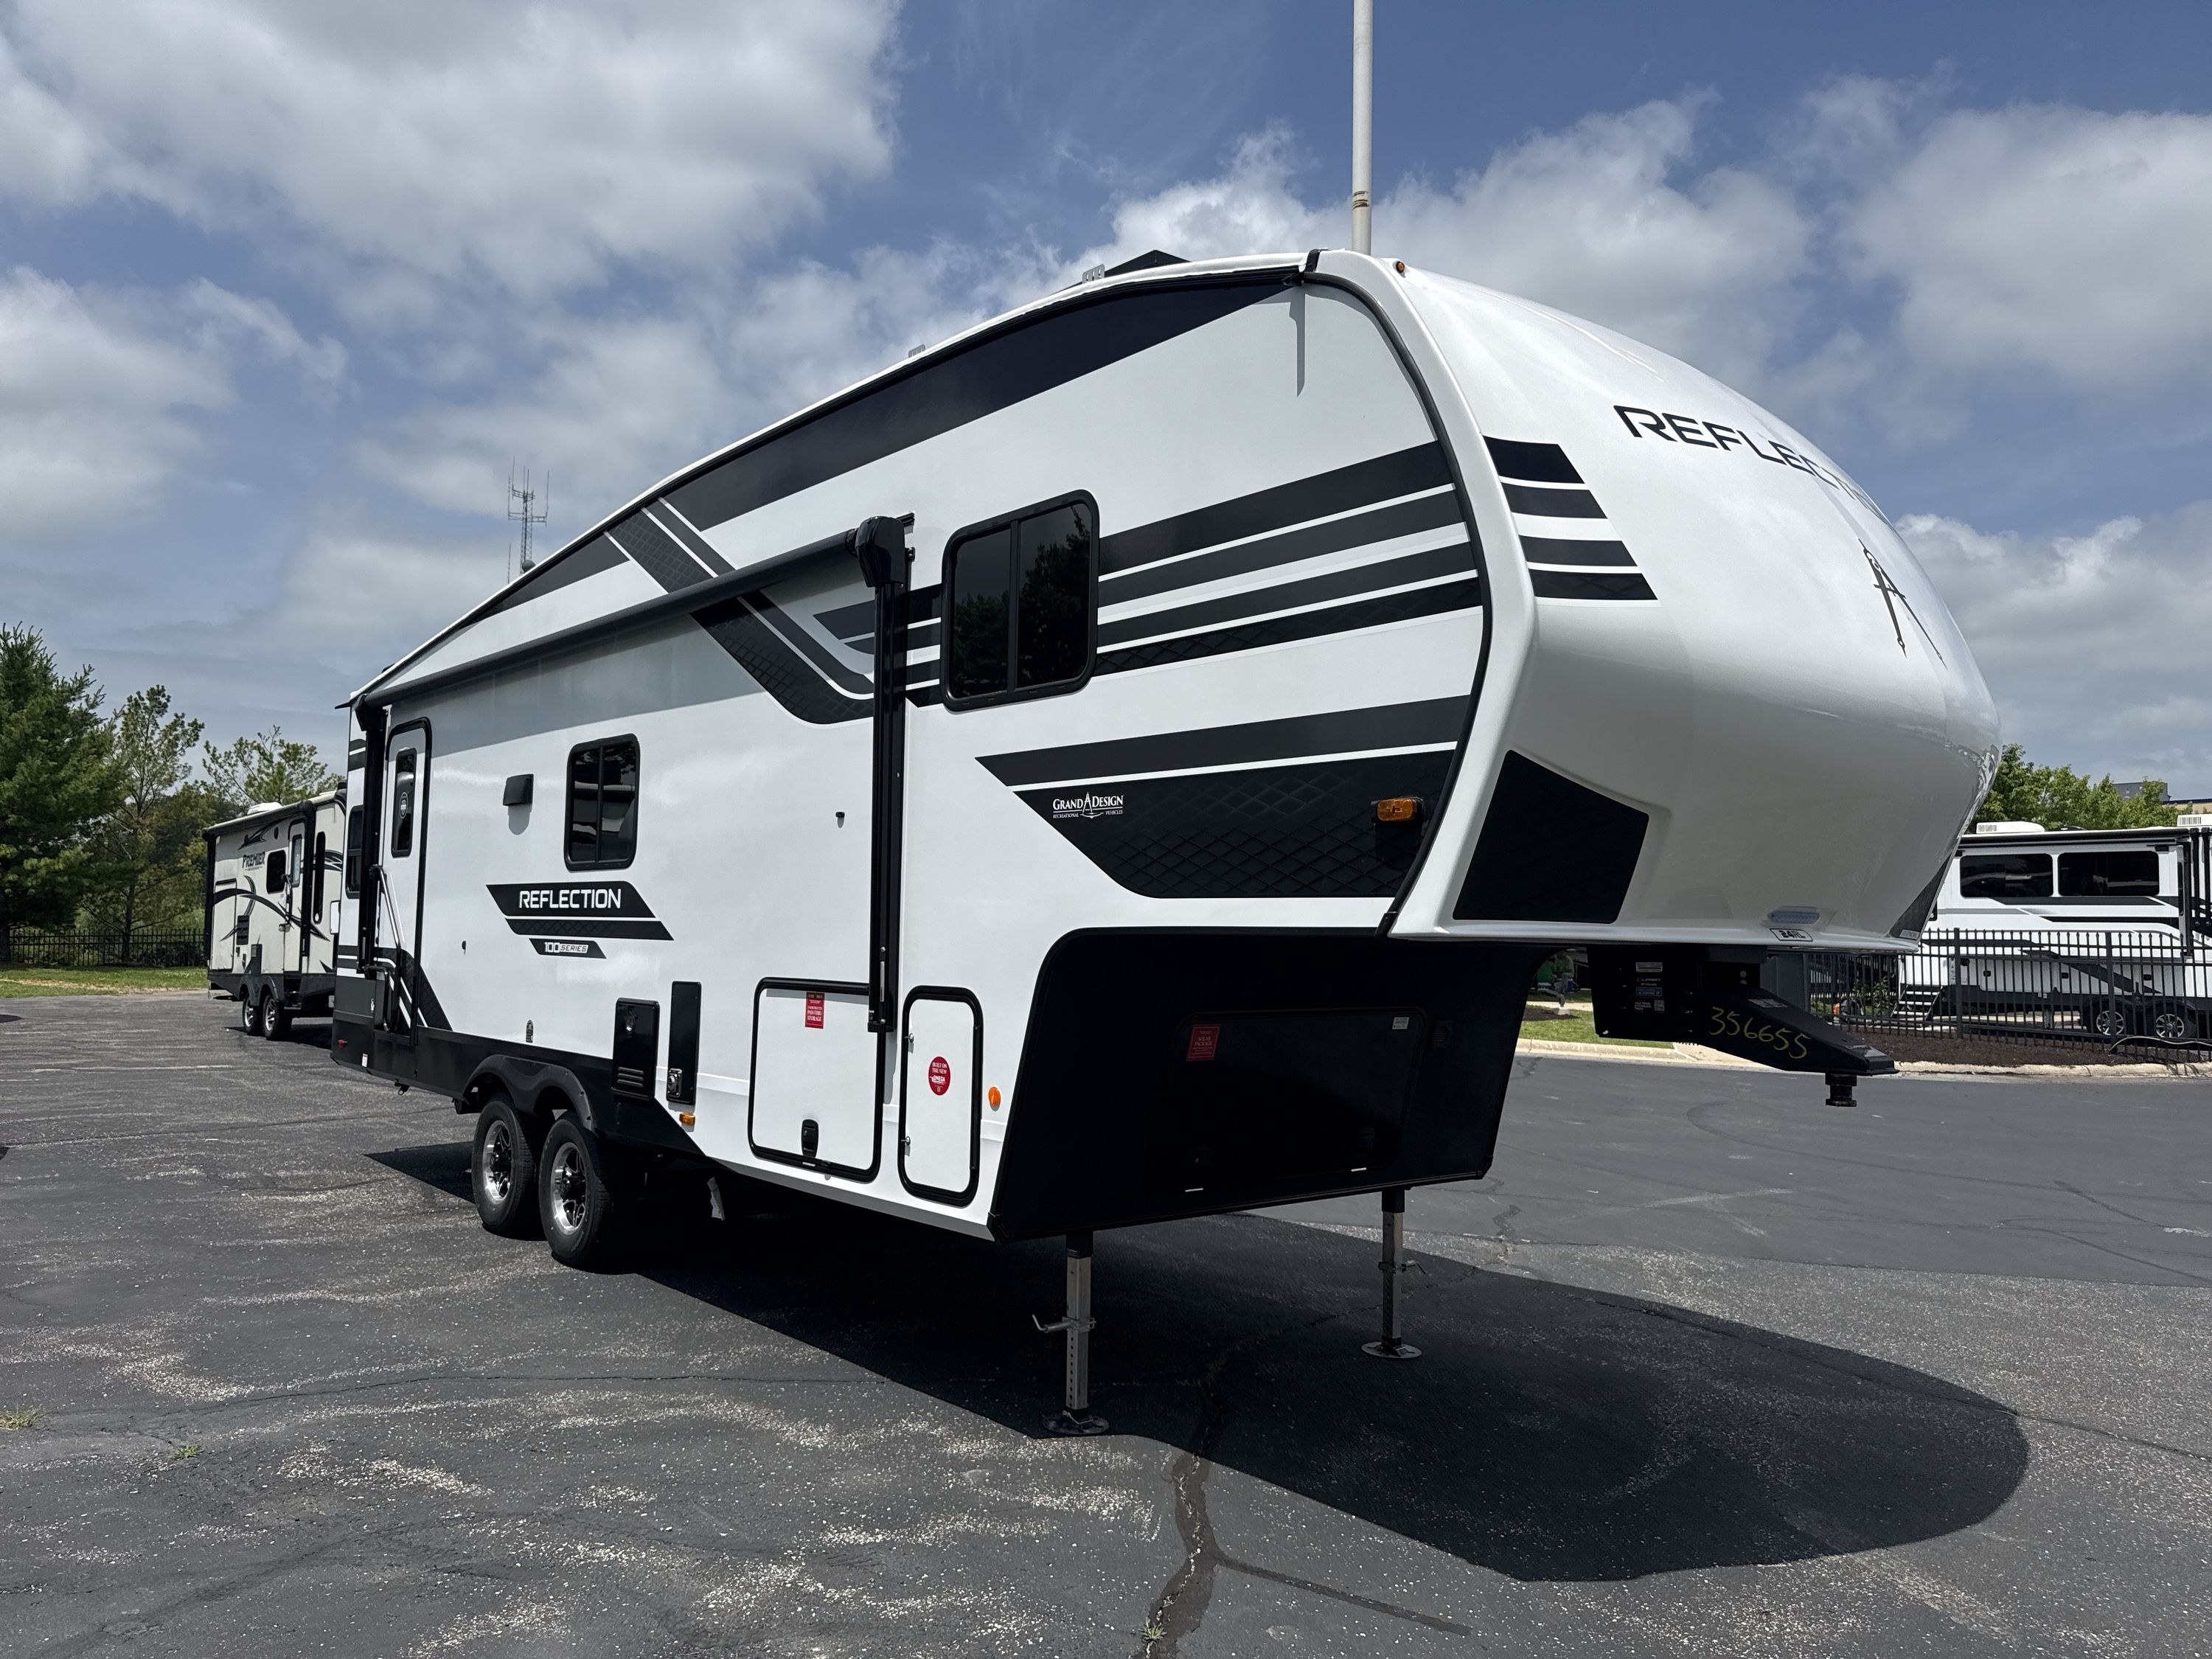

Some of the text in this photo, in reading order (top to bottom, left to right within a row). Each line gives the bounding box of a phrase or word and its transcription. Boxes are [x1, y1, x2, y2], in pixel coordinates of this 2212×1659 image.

[1052, 795, 1124, 810] GRAND DESIGN
[242, 851, 265, 869] PREMIER
[519, 888, 622, 909] REFLECTION
[544, 942, 588, 953] 100 SERIES
[1710, 1006, 1812, 1060] 356655
